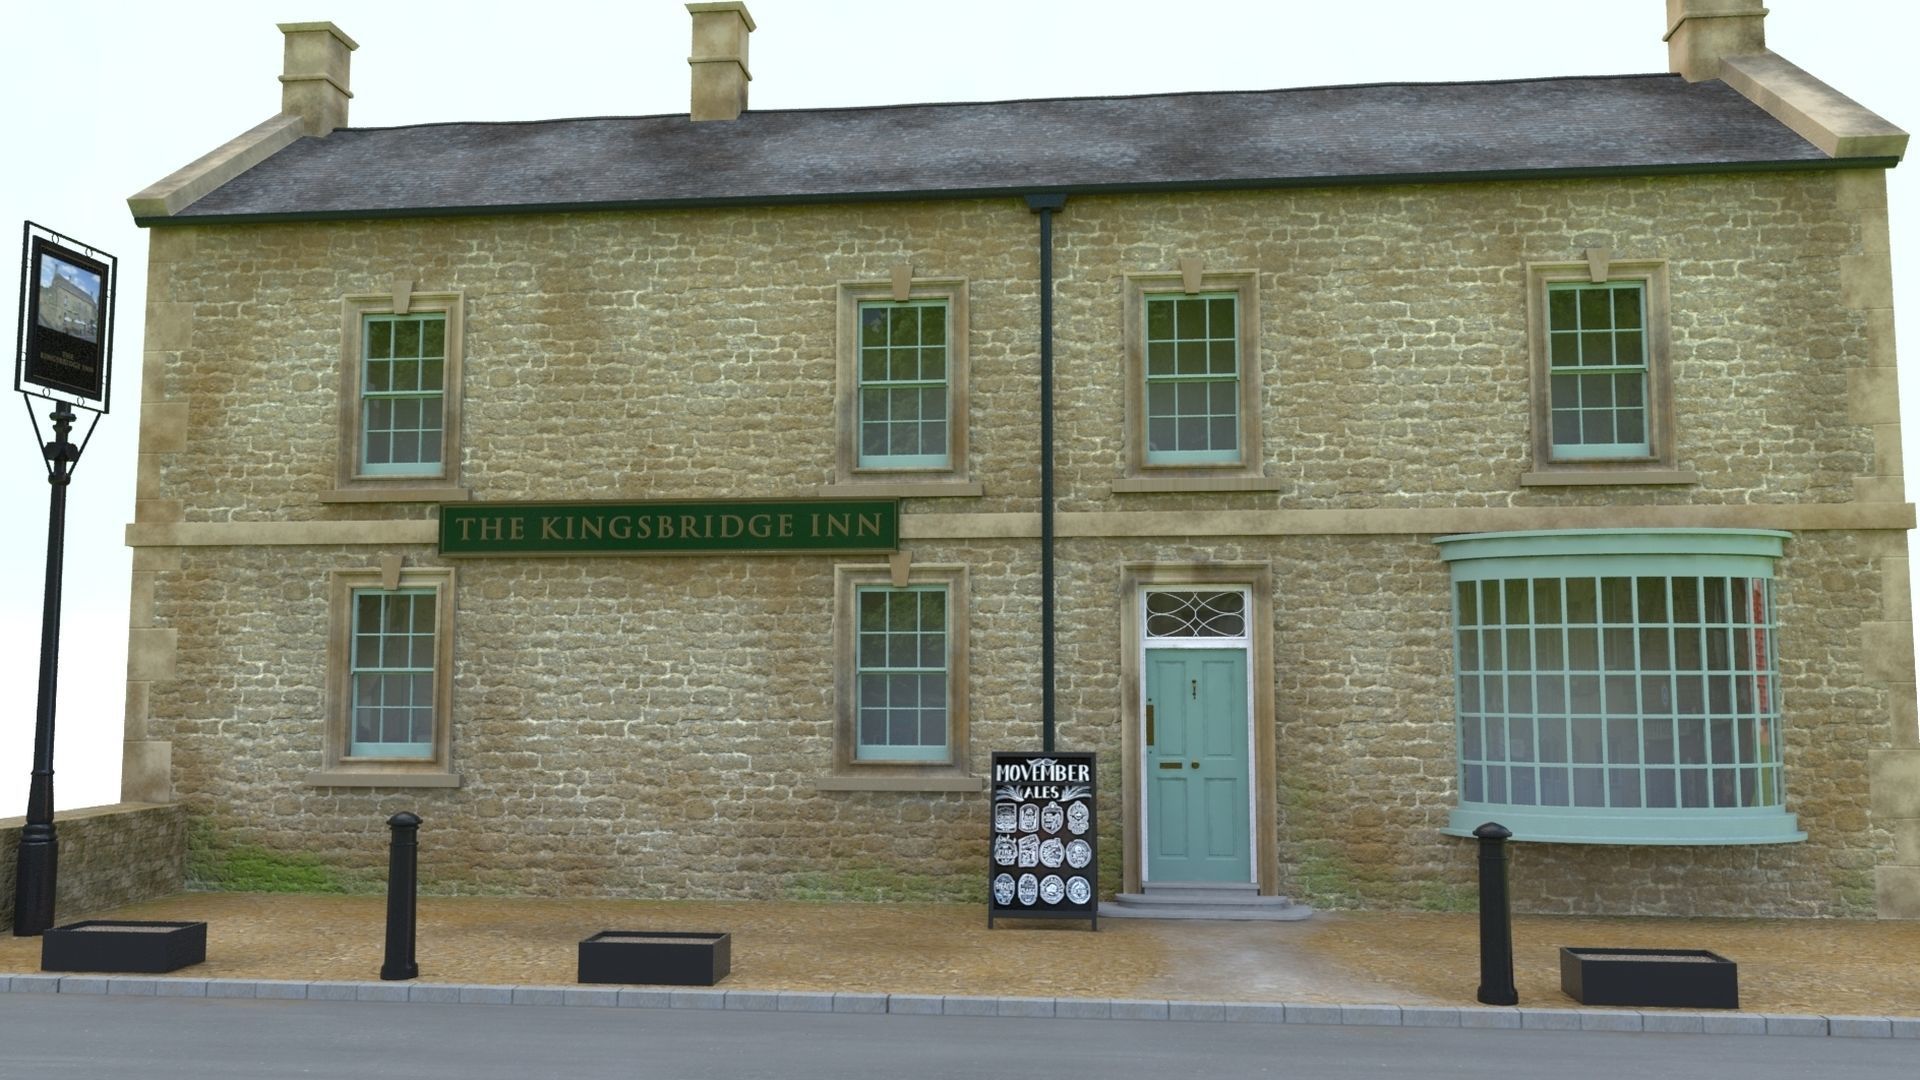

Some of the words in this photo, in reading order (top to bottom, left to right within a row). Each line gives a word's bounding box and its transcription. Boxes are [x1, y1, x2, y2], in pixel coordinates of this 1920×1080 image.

[456, 517, 525, 541] THE
[539, 514, 794, 541] KINGSBRIDGE
[811, 513, 883, 538] INN
[996, 764, 1090, 782] MOVEMBER
[1023, 785, 1059, 799] ALES
